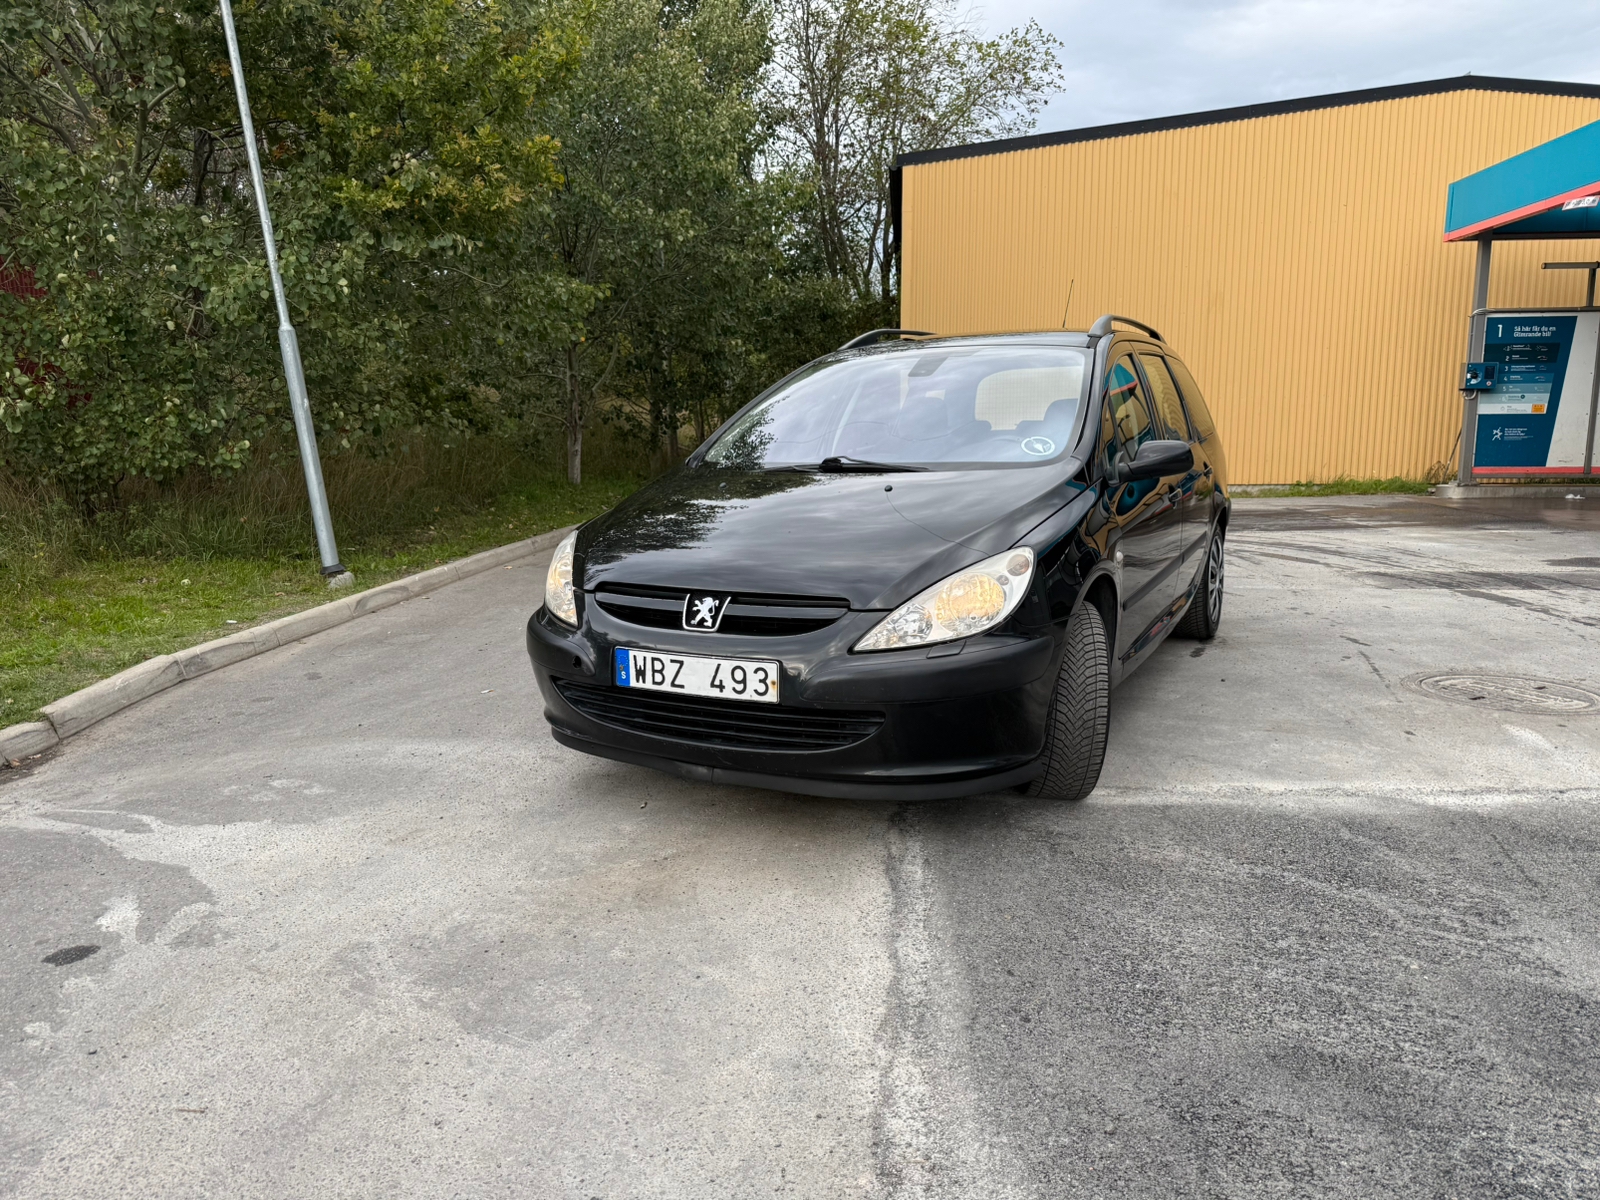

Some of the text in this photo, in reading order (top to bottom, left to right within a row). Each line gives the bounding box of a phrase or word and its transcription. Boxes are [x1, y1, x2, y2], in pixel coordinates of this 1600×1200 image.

[1497, 324, 1503, 338] 1
[621, 671, 626, 680] S
[633, 654, 770, 697] WBZ 493
